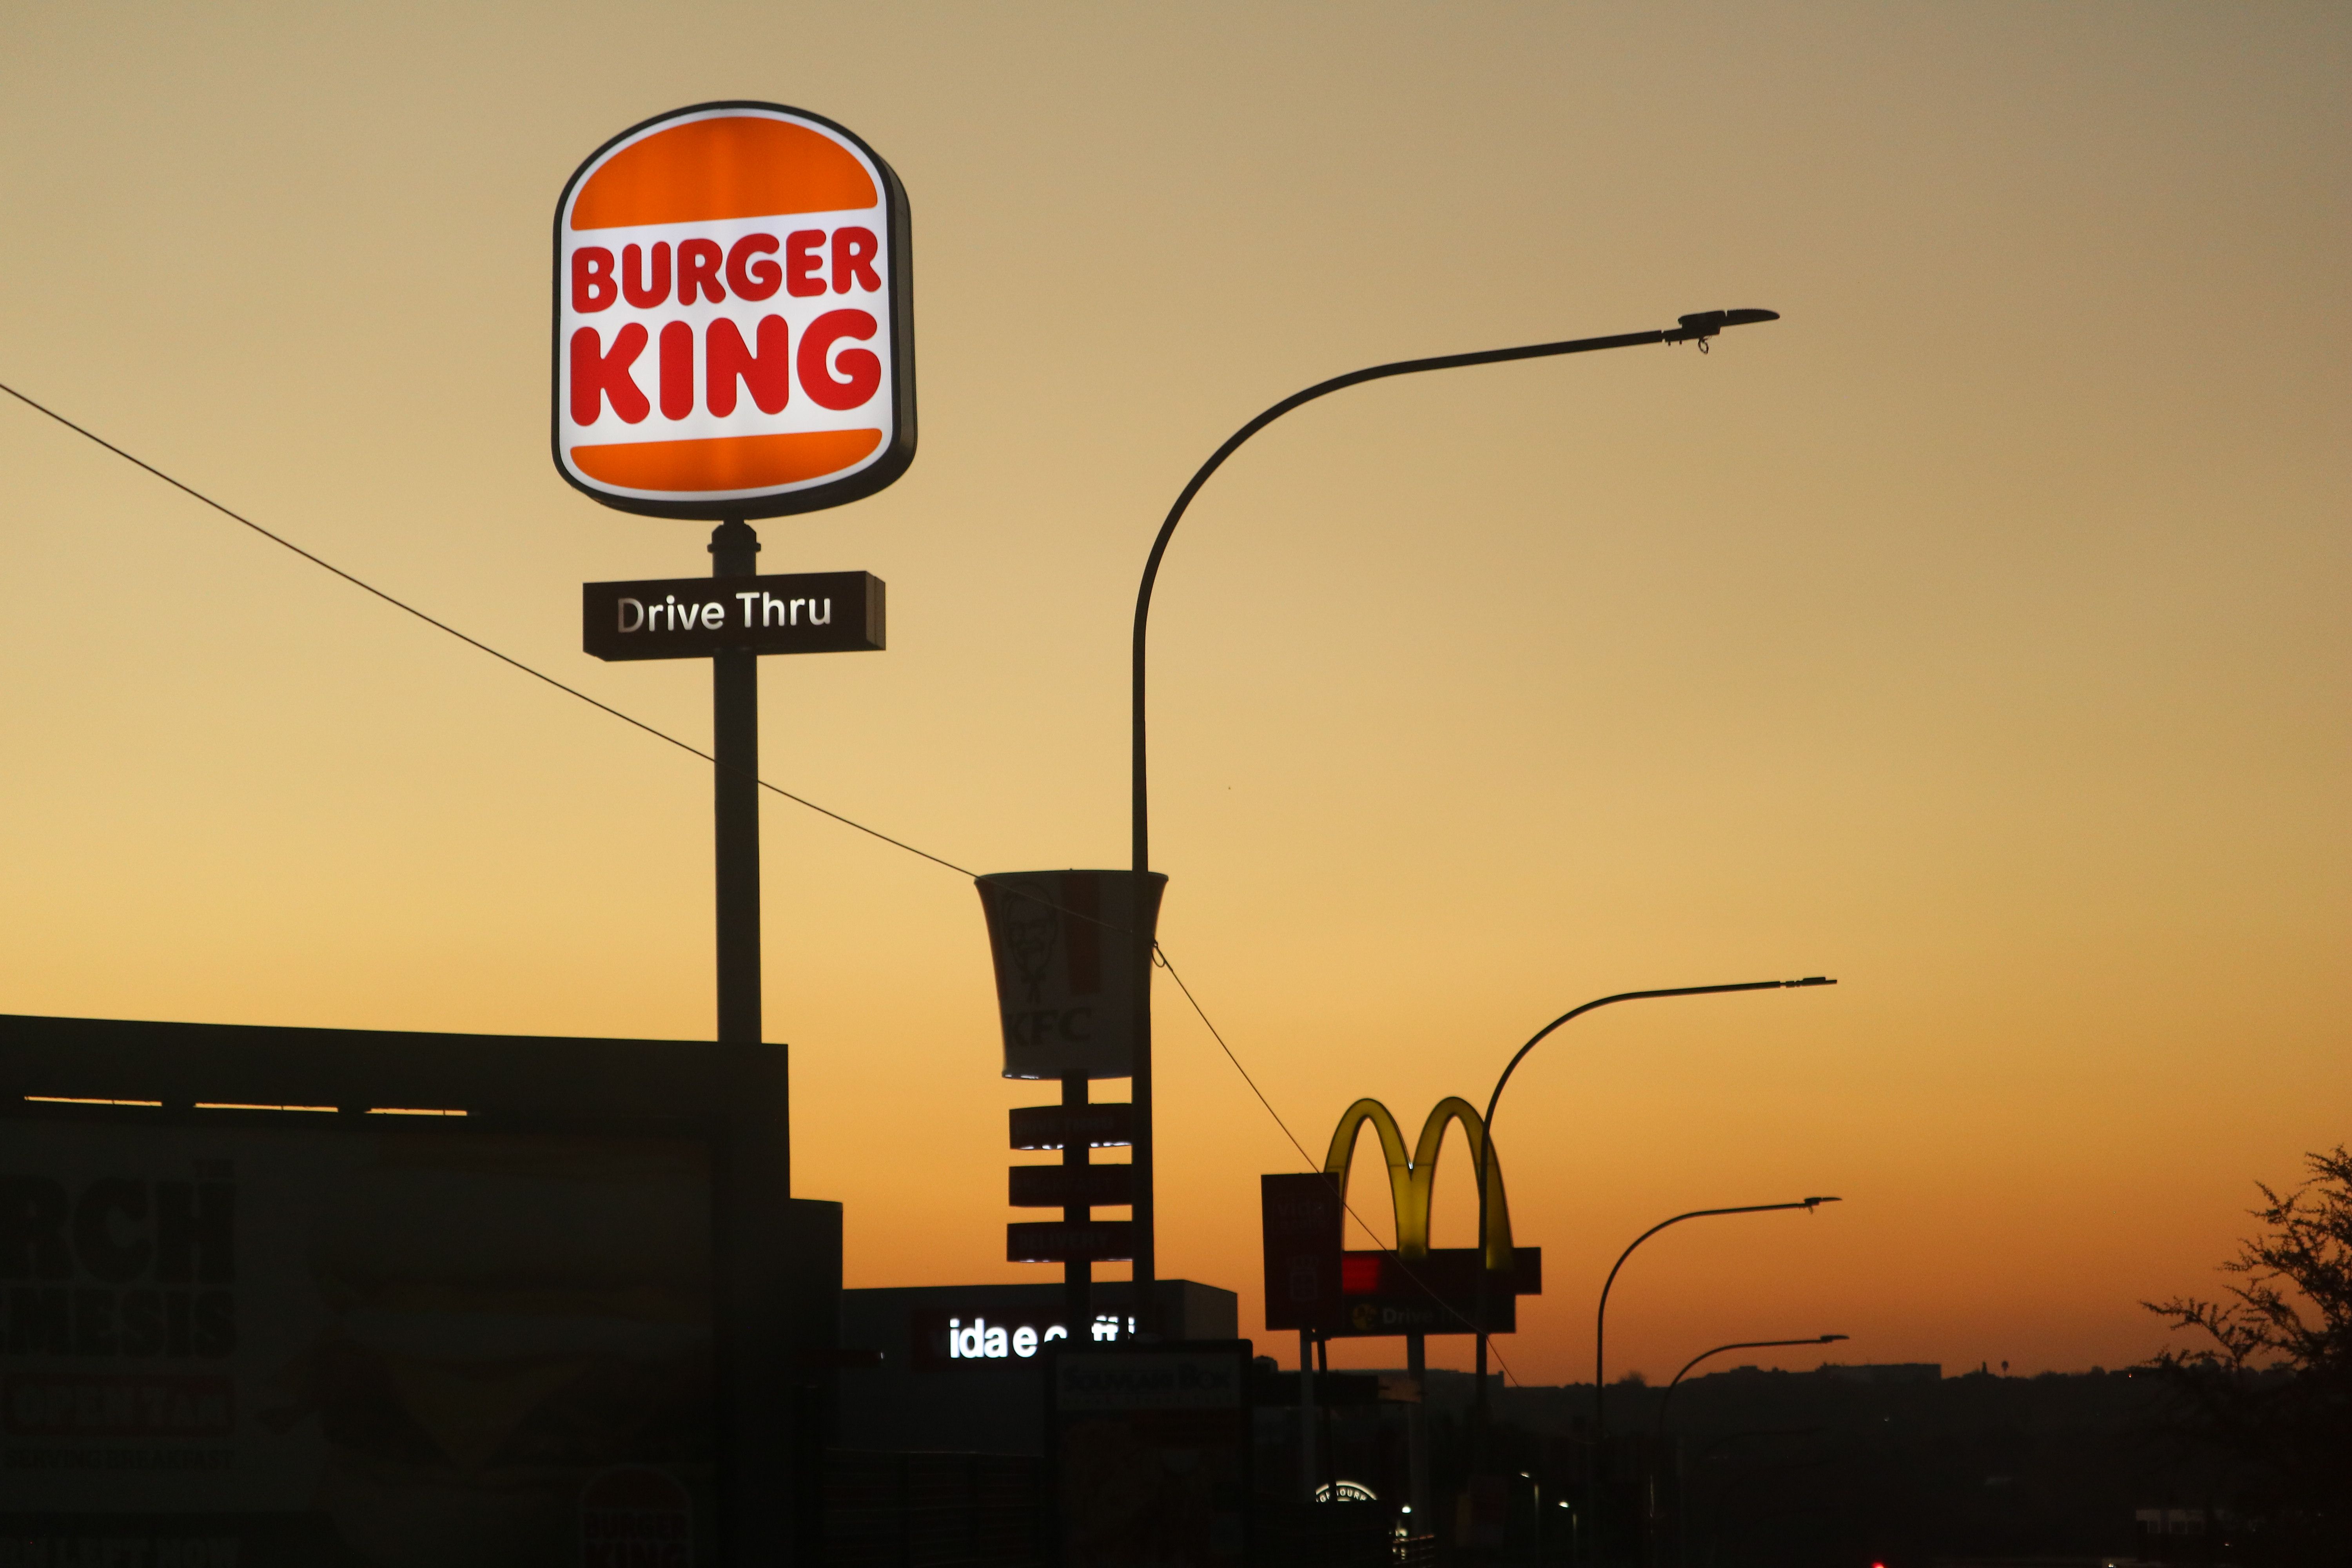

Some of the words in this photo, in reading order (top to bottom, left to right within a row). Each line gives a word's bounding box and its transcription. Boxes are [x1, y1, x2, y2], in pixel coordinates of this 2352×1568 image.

[572, 226, 881, 314] BURGER
[570, 309, 881, 426] KING
[618, 594, 724, 633] Drive
[736, 592, 830, 627] Thru
[1005, 1007, 1092, 1046] KFC
[1018, 1232, 1109, 1250] DELIVERY
[0, 1288, 237, 1359] MESIS
[1383, 1307, 1433, 1324] Drive
[13, 1384, 135, 1426] OPEN
[4, 1449, 102, 1470] SERVING
[106, 1449, 234, 1470] BREAKFAST
[584, 1512, 688, 1541] BURGER
